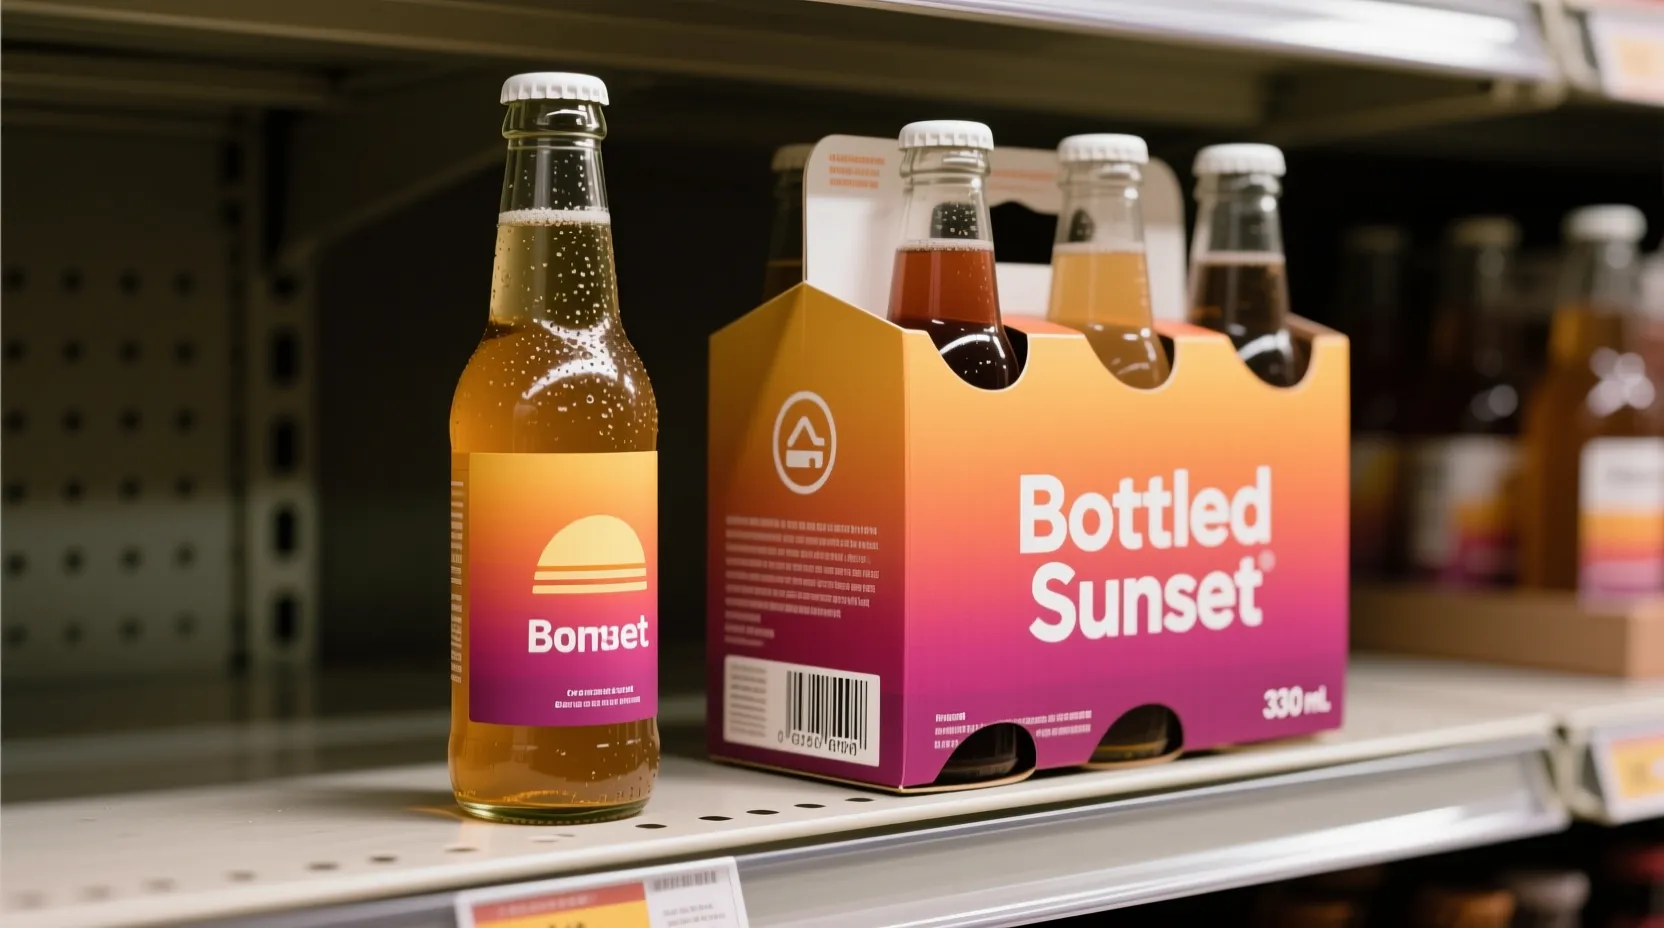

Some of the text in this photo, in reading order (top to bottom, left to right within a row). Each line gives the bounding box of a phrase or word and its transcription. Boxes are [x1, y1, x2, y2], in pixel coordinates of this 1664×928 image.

[1020, 465, 1271, 554] Bottled
[1029, 556, 1263, 643] Sunset
[1262, 685, 1303, 720] 330
